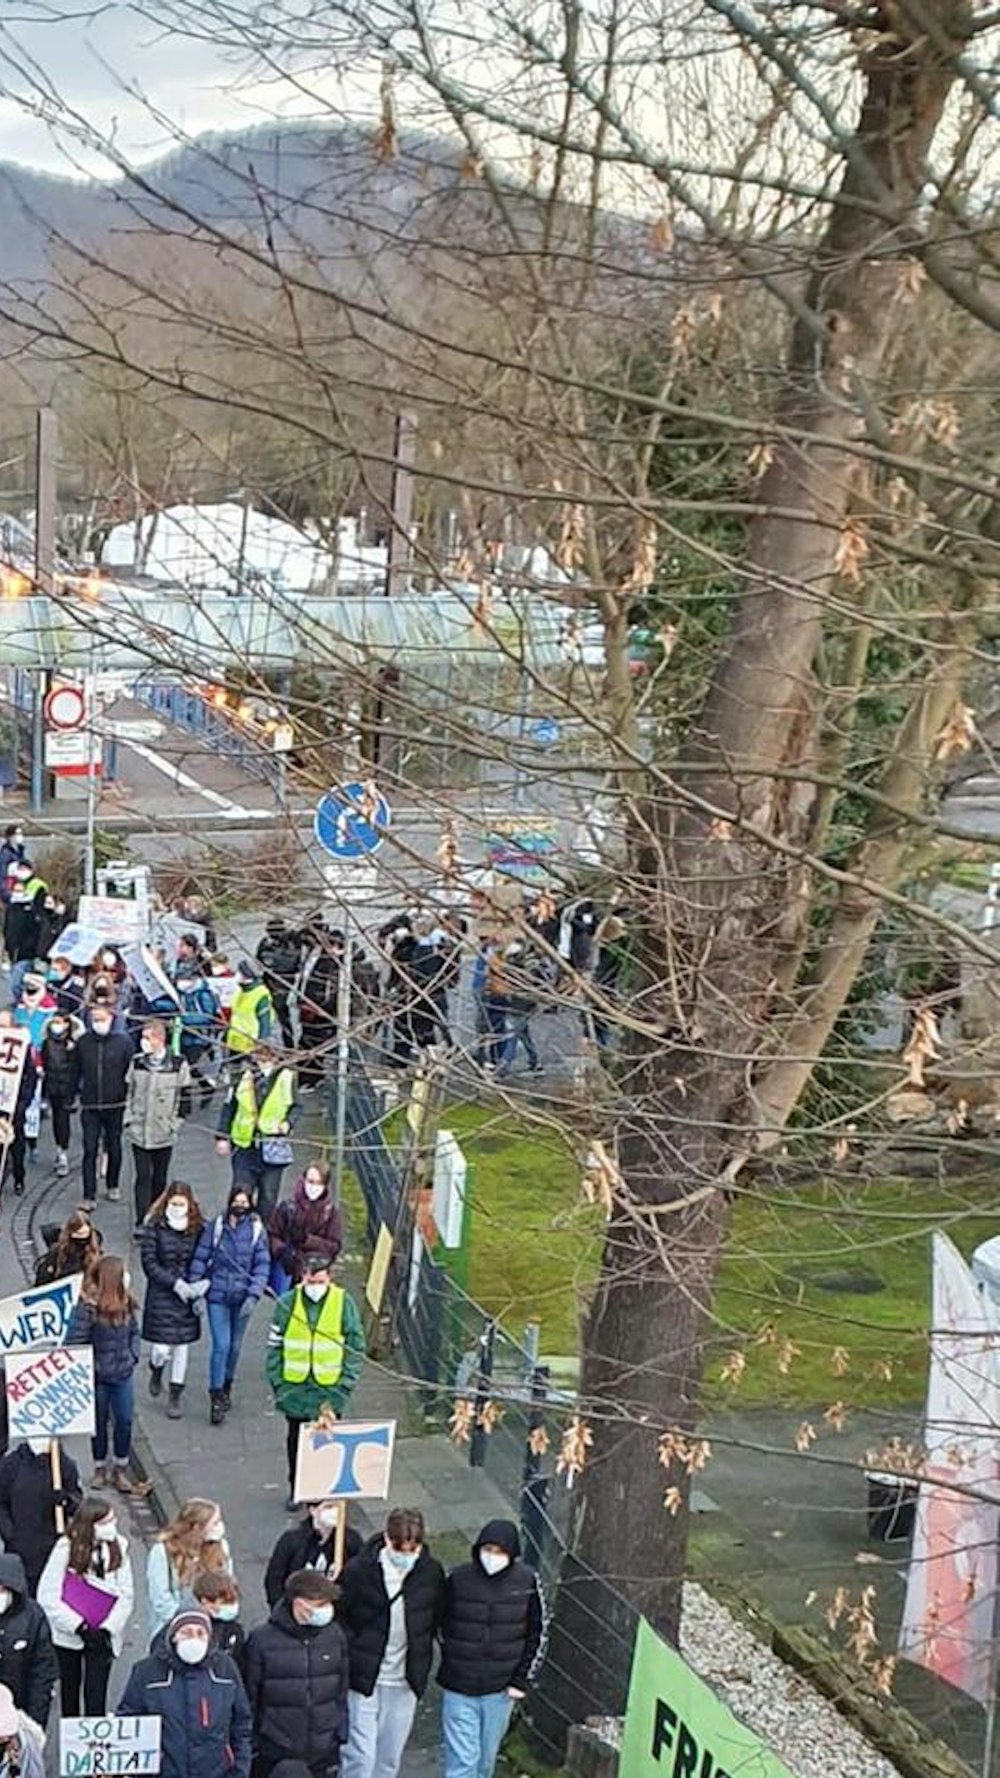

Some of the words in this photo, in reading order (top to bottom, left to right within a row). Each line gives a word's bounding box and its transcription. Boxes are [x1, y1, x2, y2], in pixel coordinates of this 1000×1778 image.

[7, 1348, 76, 1402] RETTET
[40, 1386, 93, 1433] WERTH
[78, 1719, 141, 1740] SOLI
